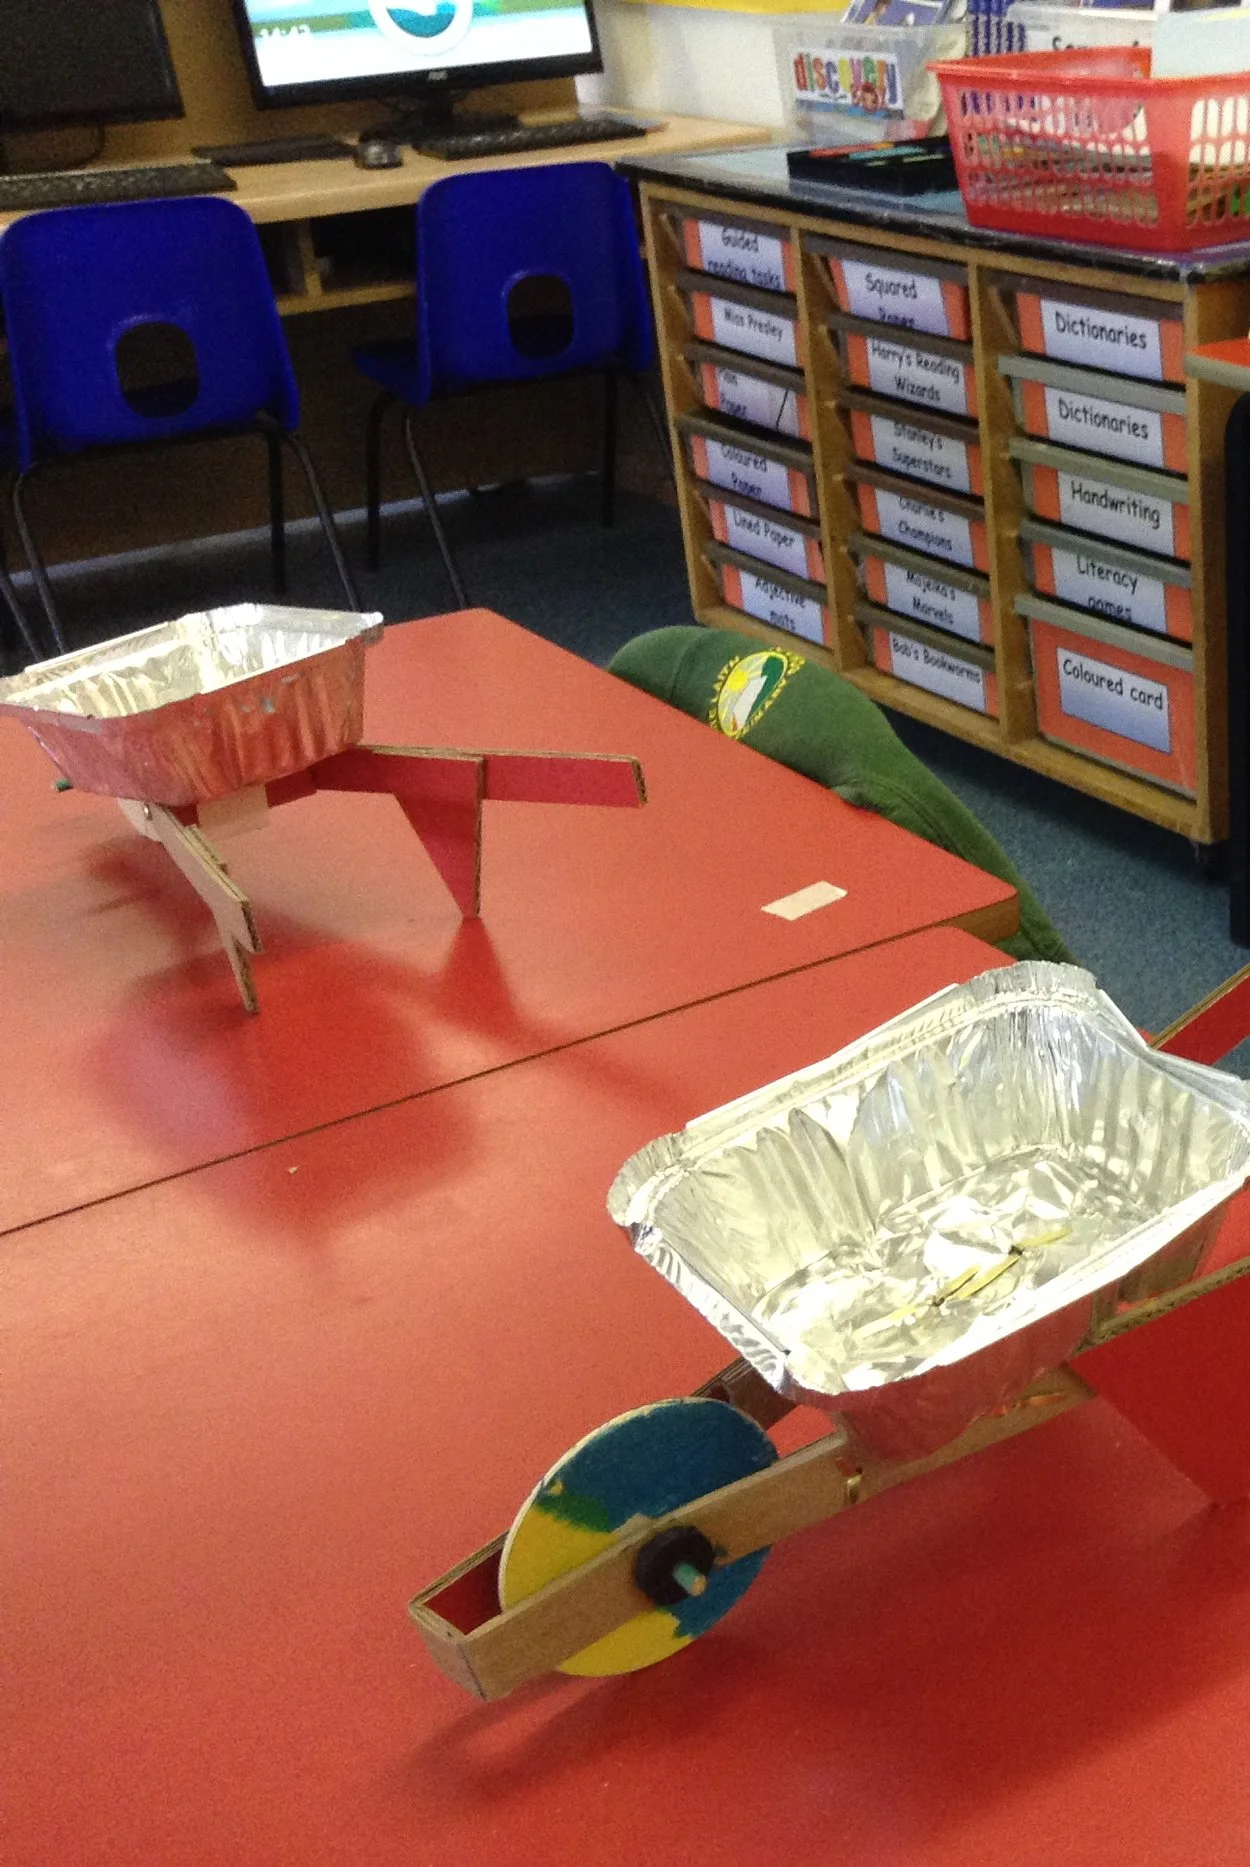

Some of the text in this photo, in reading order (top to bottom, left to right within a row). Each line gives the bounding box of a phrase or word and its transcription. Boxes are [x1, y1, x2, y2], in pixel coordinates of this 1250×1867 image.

[721, 228, 759, 253] Guided
[864, 272, 918, 299] Squared
[1055, 310, 1148, 350] Dictionaries
[872, 340, 914, 368] Harry's
[894, 376, 942, 402] Wizards
[1058, 397, 1149, 440] Dictionaries
[892, 446, 952, 479] Superstars
[1071, 480, 1160, 530] Handwriting
[762, 522, 795, 548] Paper
[898, 520, 953, 551] Champions
[1077, 554, 1139, 595] Literacy
[912, 596, 954, 625] Marvels
[1088, 596, 1133, 624] games
[892, 638, 981, 684] Bob's Bookworms
[1062, 658, 1164, 710] Coloured card
